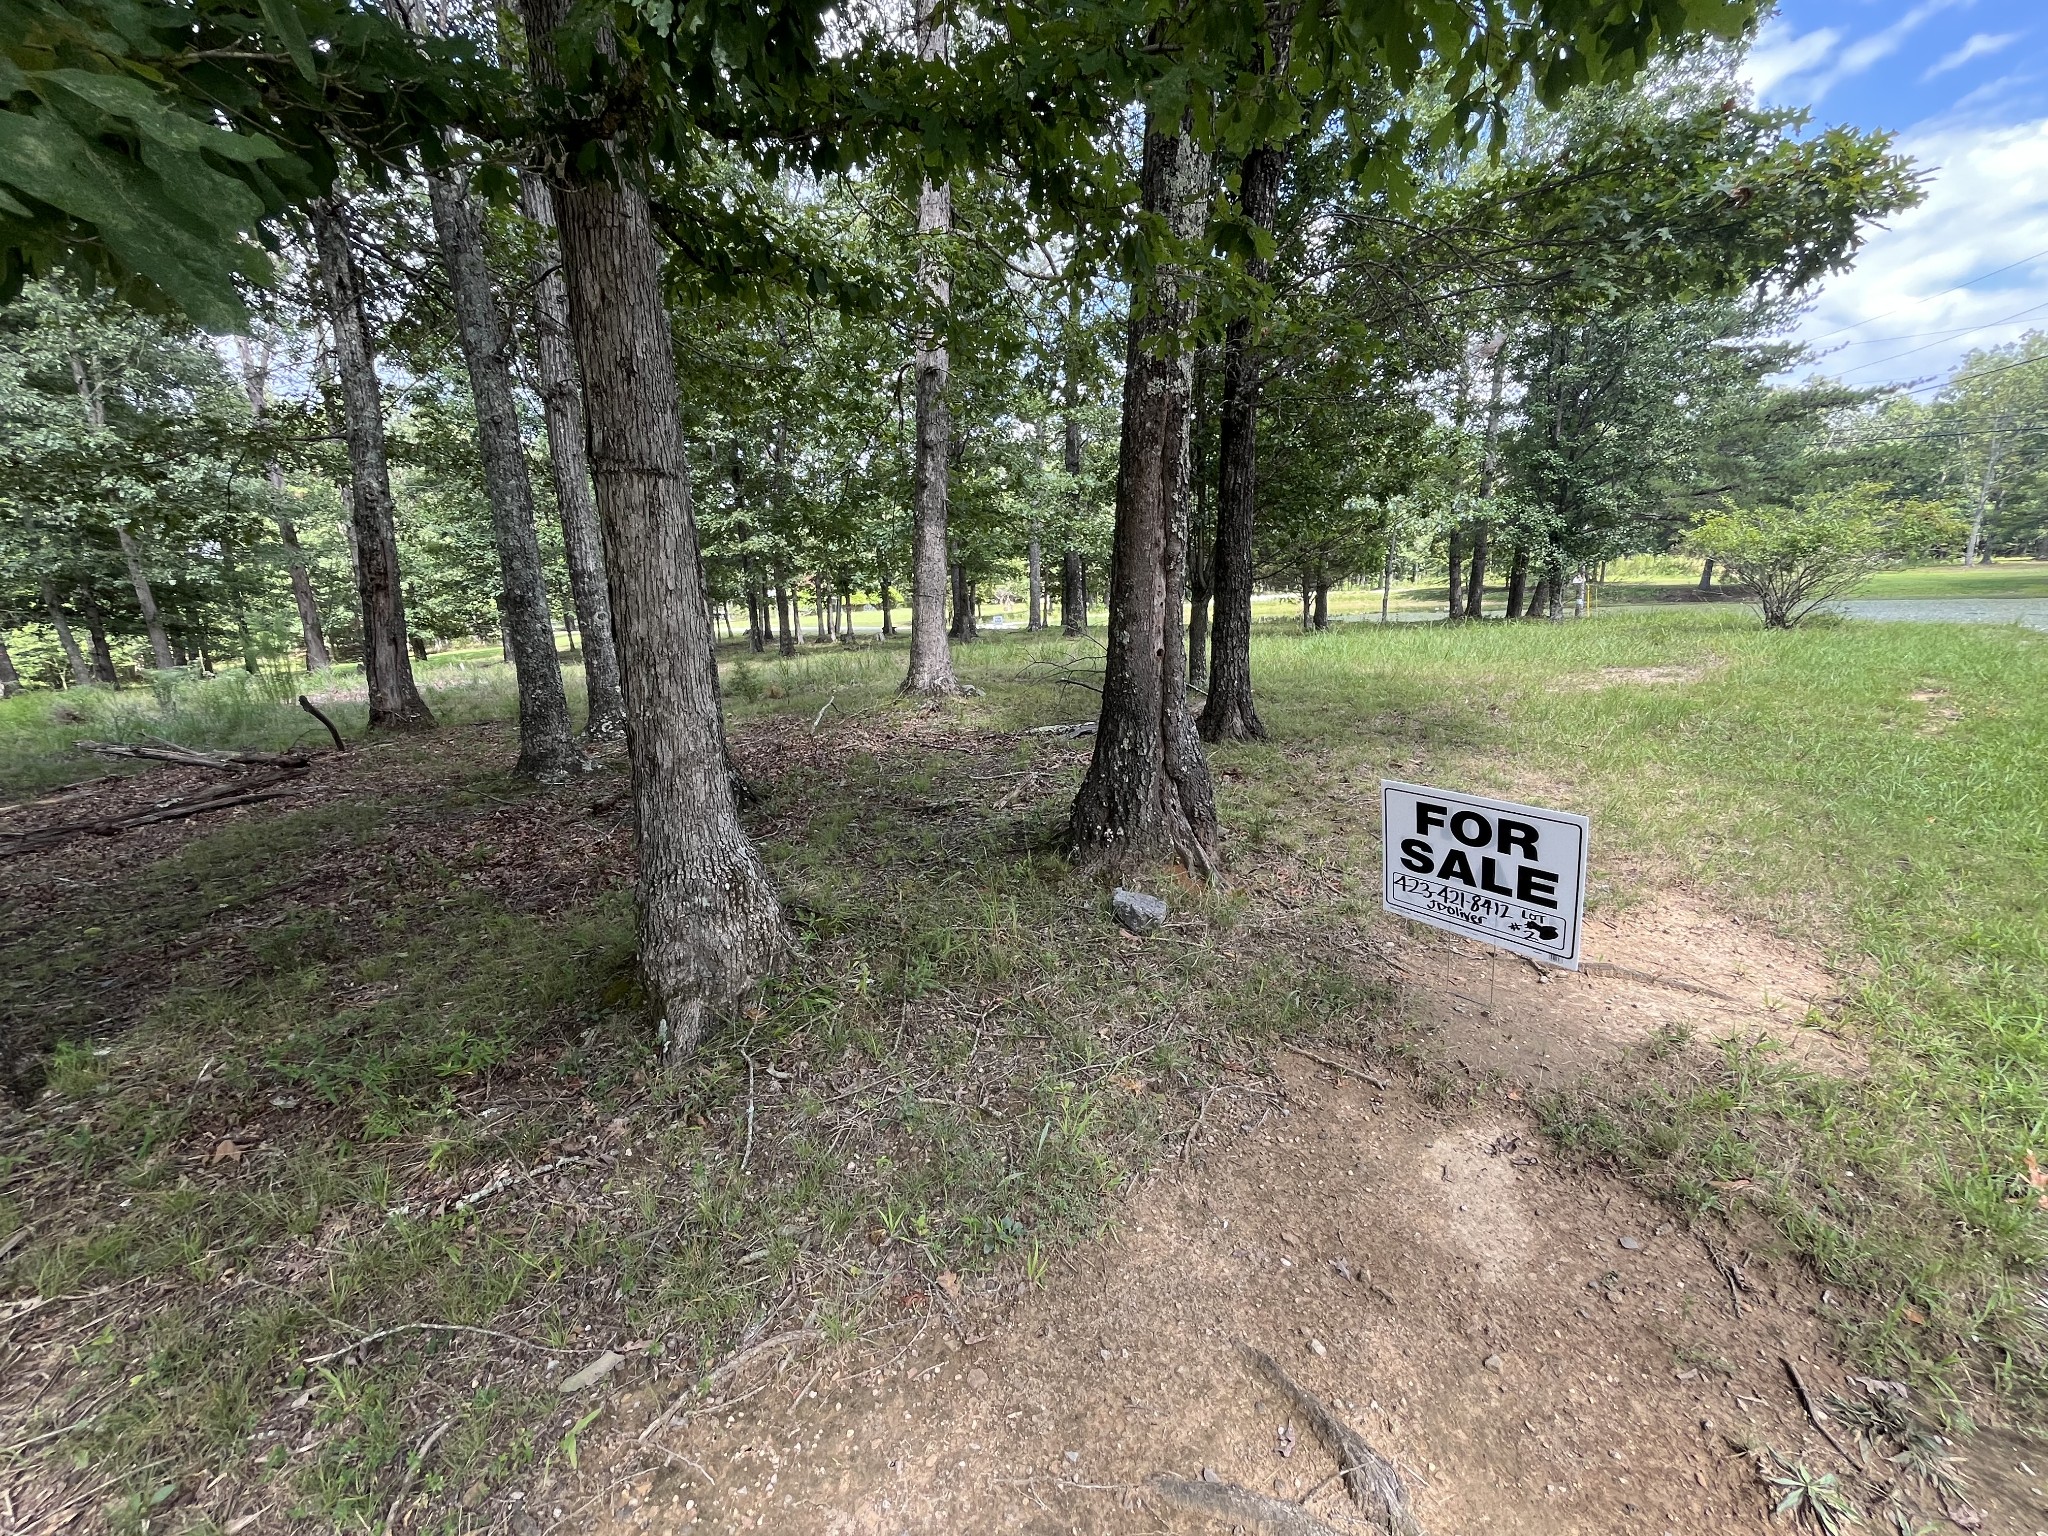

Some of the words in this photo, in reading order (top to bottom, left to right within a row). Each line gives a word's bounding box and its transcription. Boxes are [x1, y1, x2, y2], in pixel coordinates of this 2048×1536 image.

[1416, 801, 1539, 861] FOR
[1394, 876, 1514, 918] 423-421-8412
[1400, 838, 1559, 910] SALE
